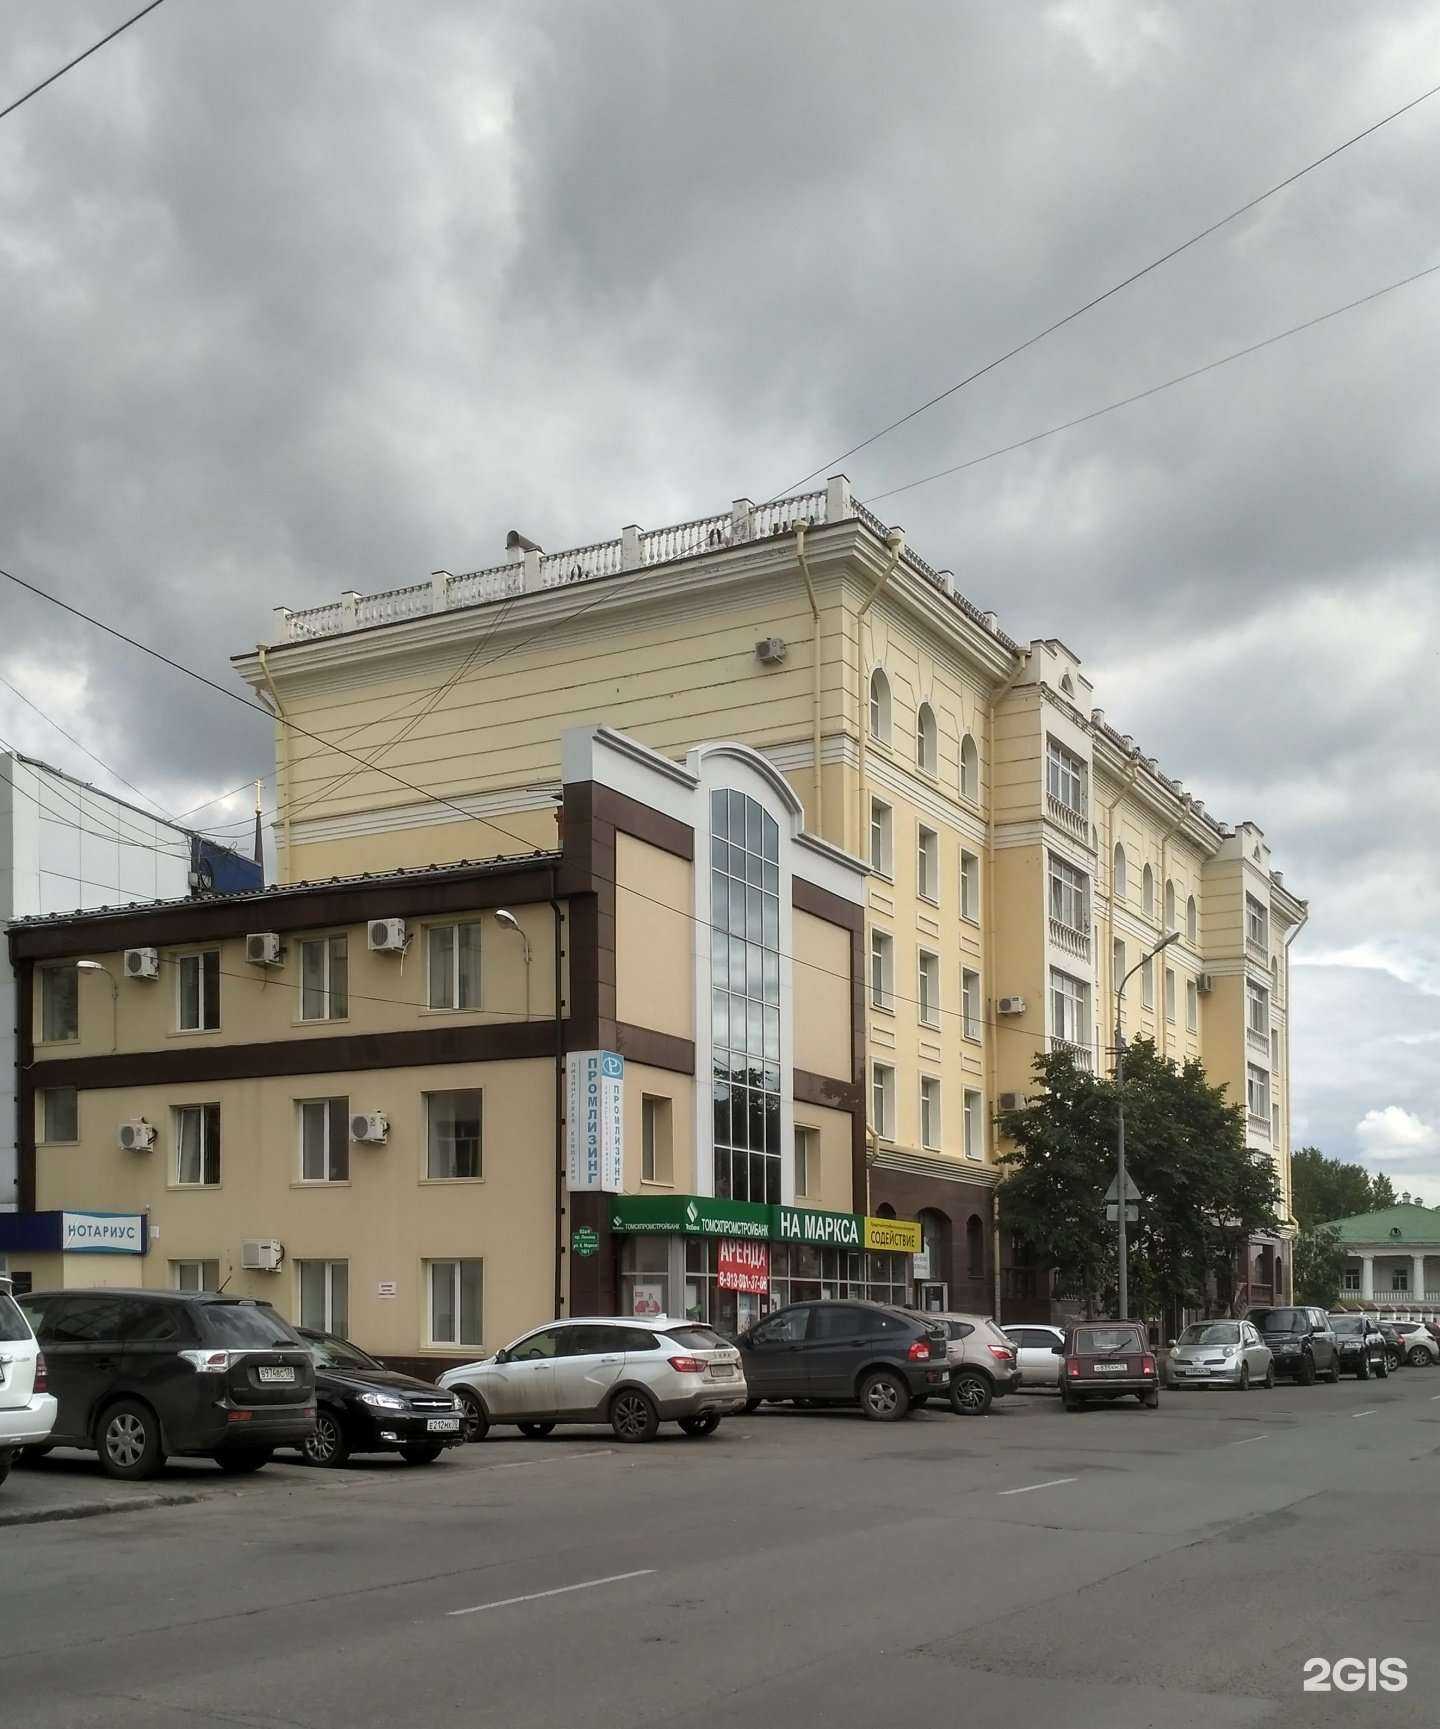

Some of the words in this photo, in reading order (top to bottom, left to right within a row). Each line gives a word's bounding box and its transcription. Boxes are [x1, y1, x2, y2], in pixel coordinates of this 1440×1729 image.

[587, 1057, 599, 1184] ПРОМЛИЗИНГ
[613, 1084, 621, 1187] ПРОМЛИЗИНГ
[68, 1224, 136, 1240] НОТАРИУС
[701, 1217, 769, 1237] ТОМСКПРОМСТРОЙБАНК
[780, 1211, 800, 1238] НА
[804, 1214, 859, 1244] МАРКСА
[870, 1230, 915, 1248] СОДЕЙСТВИЕ
[720, 1239, 767, 1269] АРЕНДА
